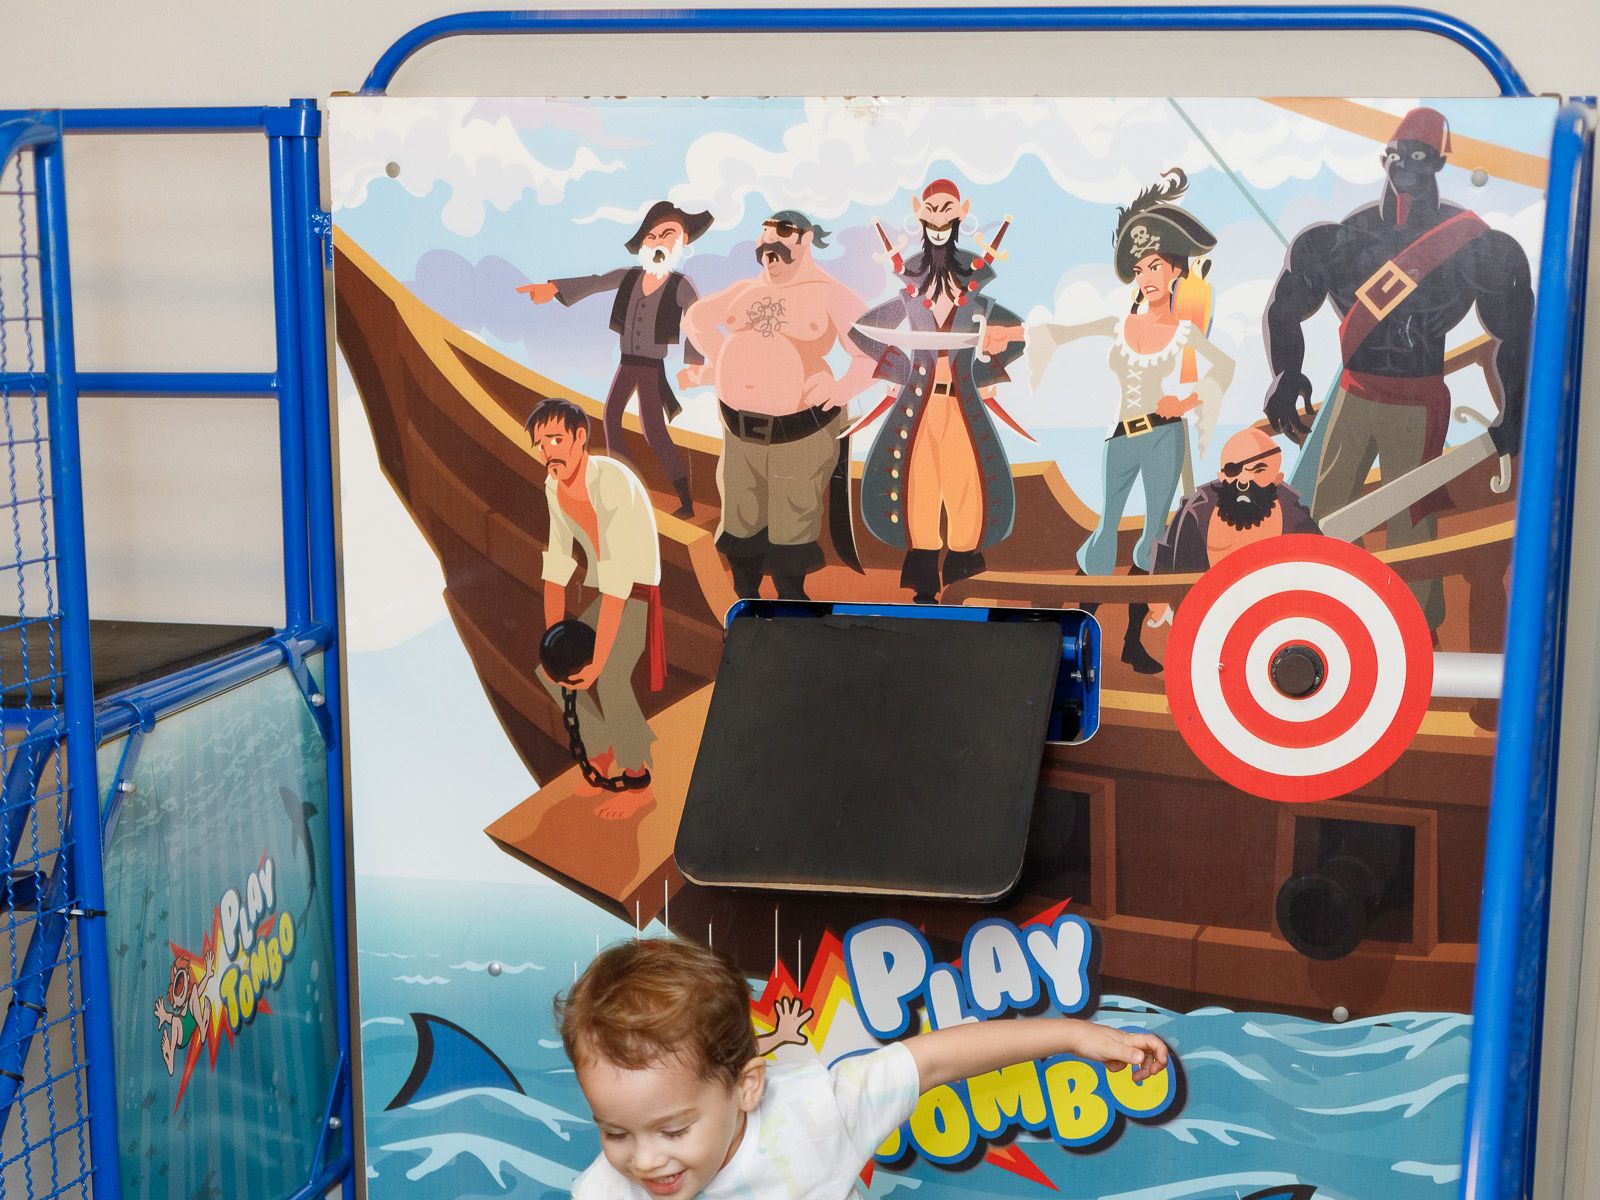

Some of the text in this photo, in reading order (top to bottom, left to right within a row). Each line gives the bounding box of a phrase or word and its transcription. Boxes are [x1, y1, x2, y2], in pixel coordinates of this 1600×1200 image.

[220, 858, 274, 955] PLAY
[219, 911, 294, 1029] TOMBO
[848, 919, 1088, 1034] PLAY
[874, 1058, 1170, 1158] OMBO
